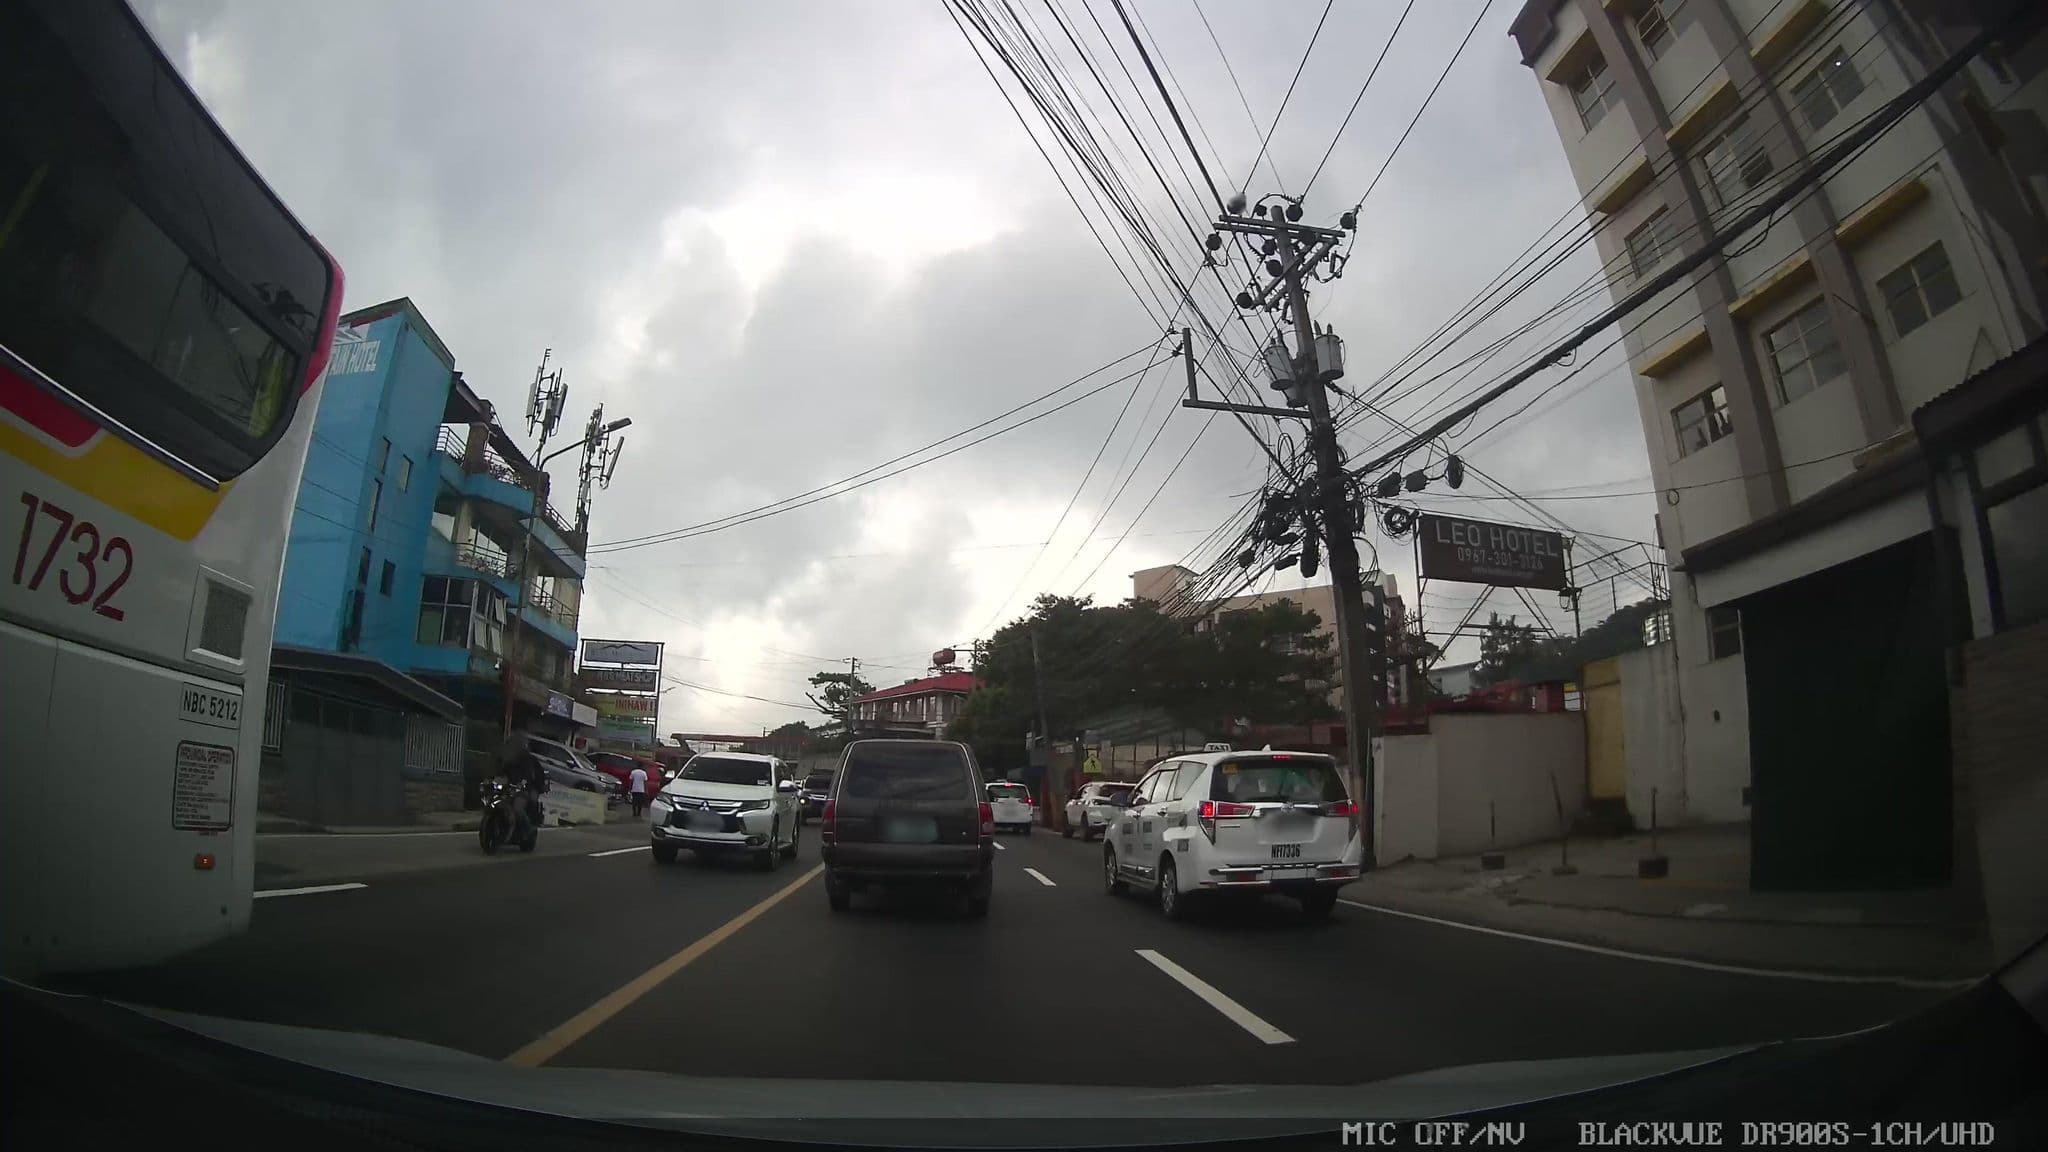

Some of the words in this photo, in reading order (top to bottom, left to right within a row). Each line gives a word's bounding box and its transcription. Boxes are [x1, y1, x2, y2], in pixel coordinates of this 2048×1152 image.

[346, 340, 381, 373] HOTEL
[1435, 520, 1481, 547] LEO
[1489, 526, 1558, 557] HOTEL
[12, 491, 134, 623] 1732
[183, 690, 206, 715] NBC
[209, 696, 238, 721] 5212
